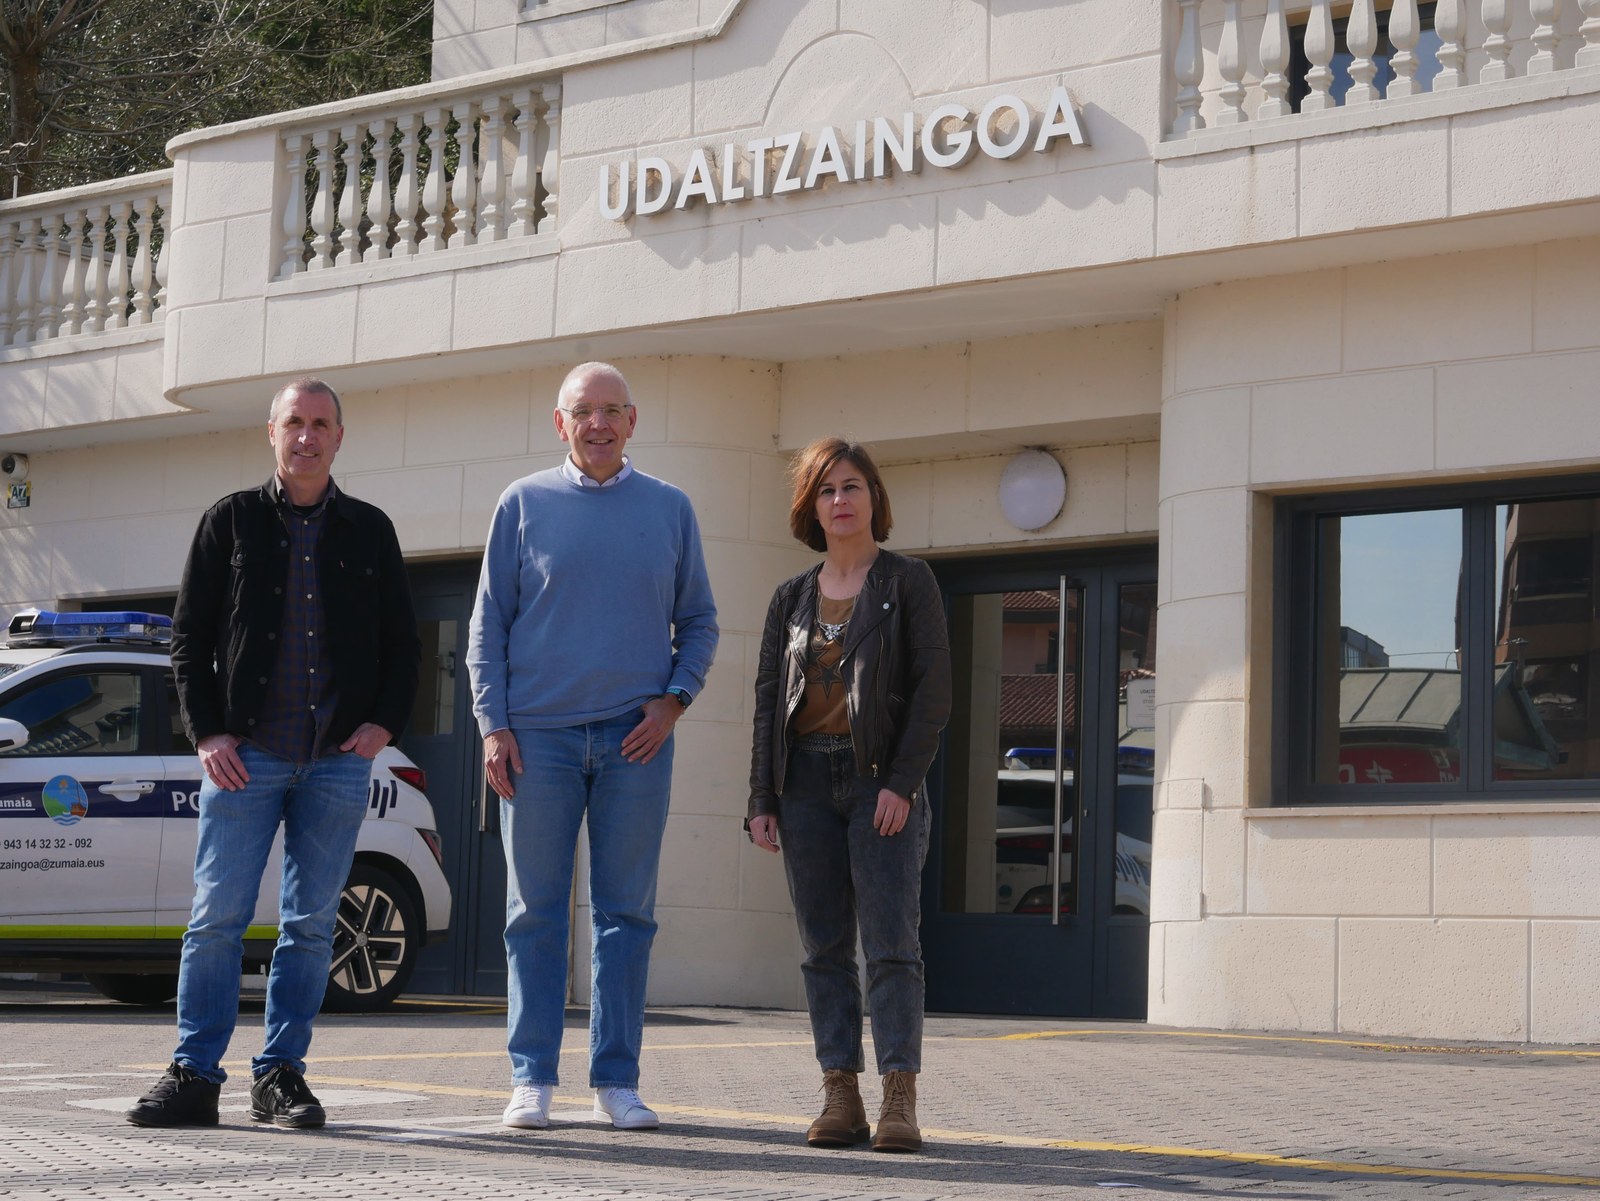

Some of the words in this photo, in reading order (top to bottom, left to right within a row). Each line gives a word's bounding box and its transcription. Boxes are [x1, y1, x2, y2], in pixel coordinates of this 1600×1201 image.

[599, 86, 1086, 221] UDALTZAINGOA
[3, 839, 22, 850] 943
[25, 839, 37, 849] 14
[39, 839, 51, 849] 32
[54, 838, 66, 849] 32
[75, 838, 92, 848] 092
